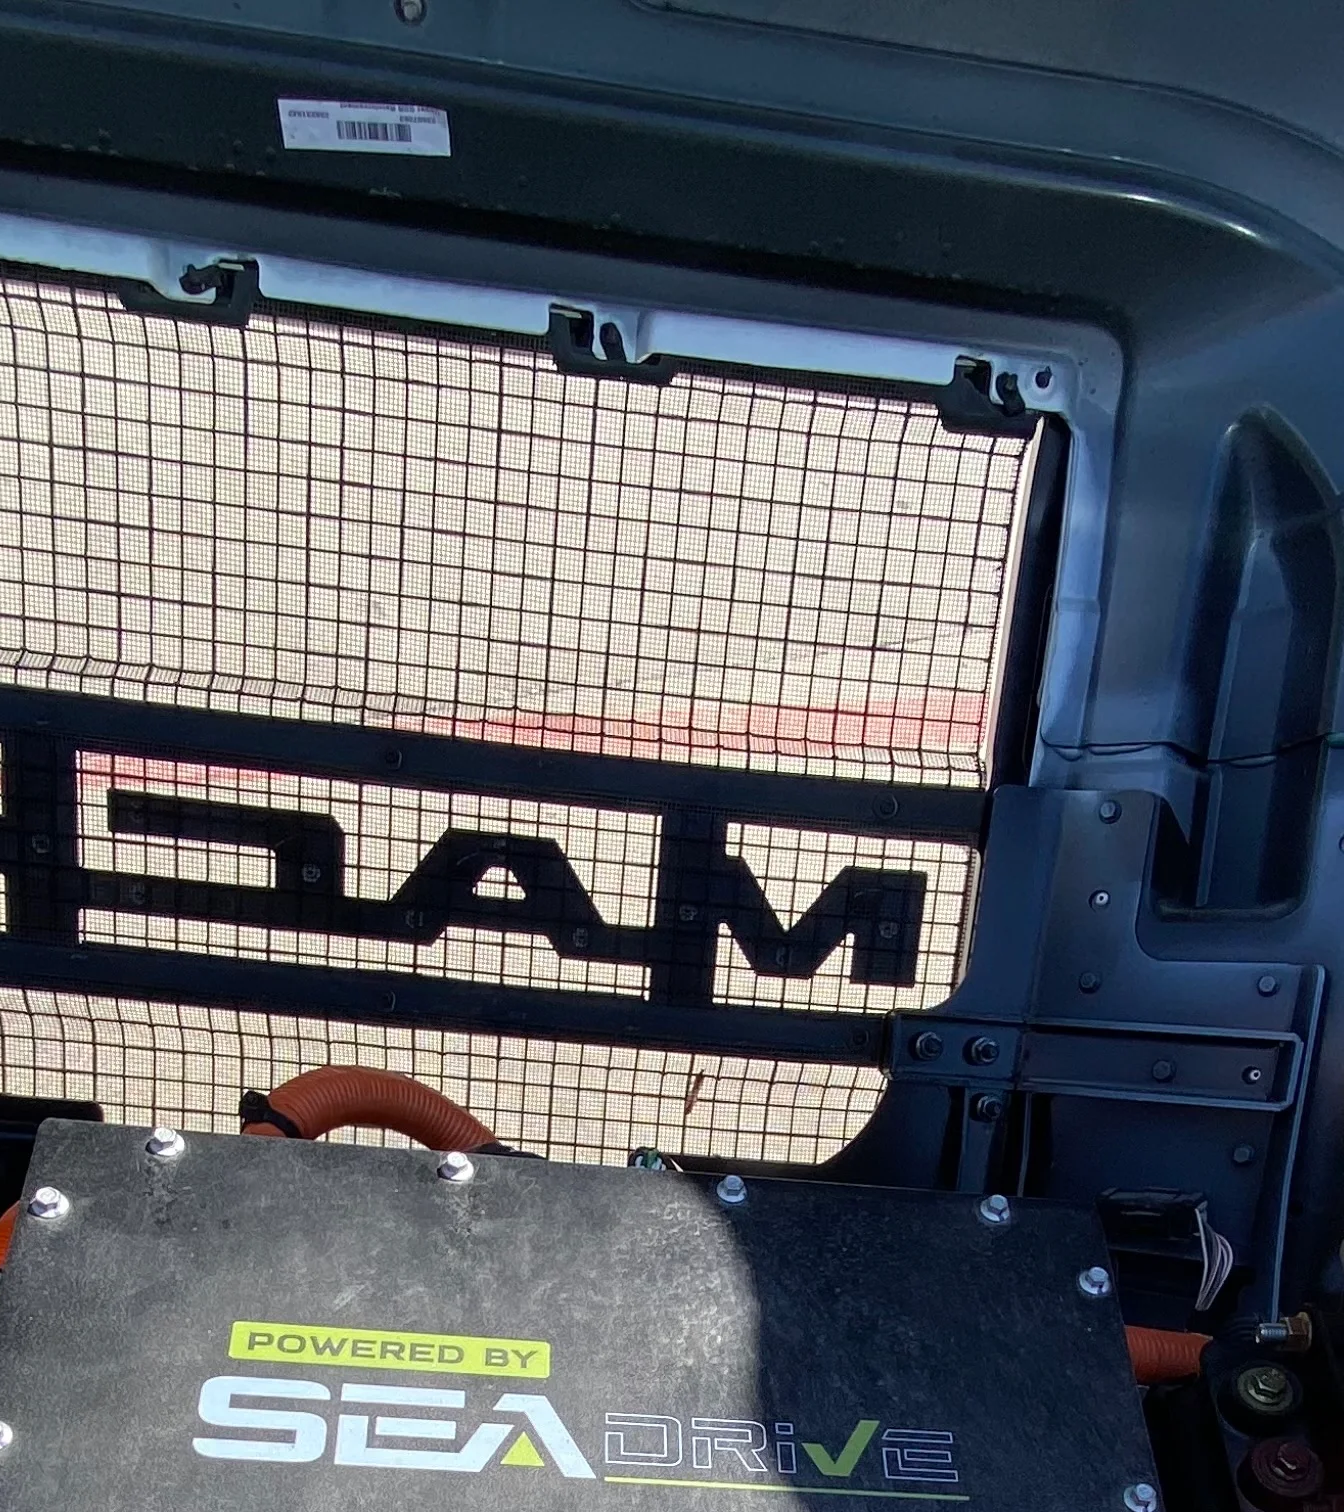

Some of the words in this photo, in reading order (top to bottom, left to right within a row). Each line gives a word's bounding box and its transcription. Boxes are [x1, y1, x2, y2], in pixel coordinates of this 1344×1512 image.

[246, 1331, 466, 1366] POWERED
[484, 1347, 540, 1370] BY
[191, 1375, 597, 1479] SEA
